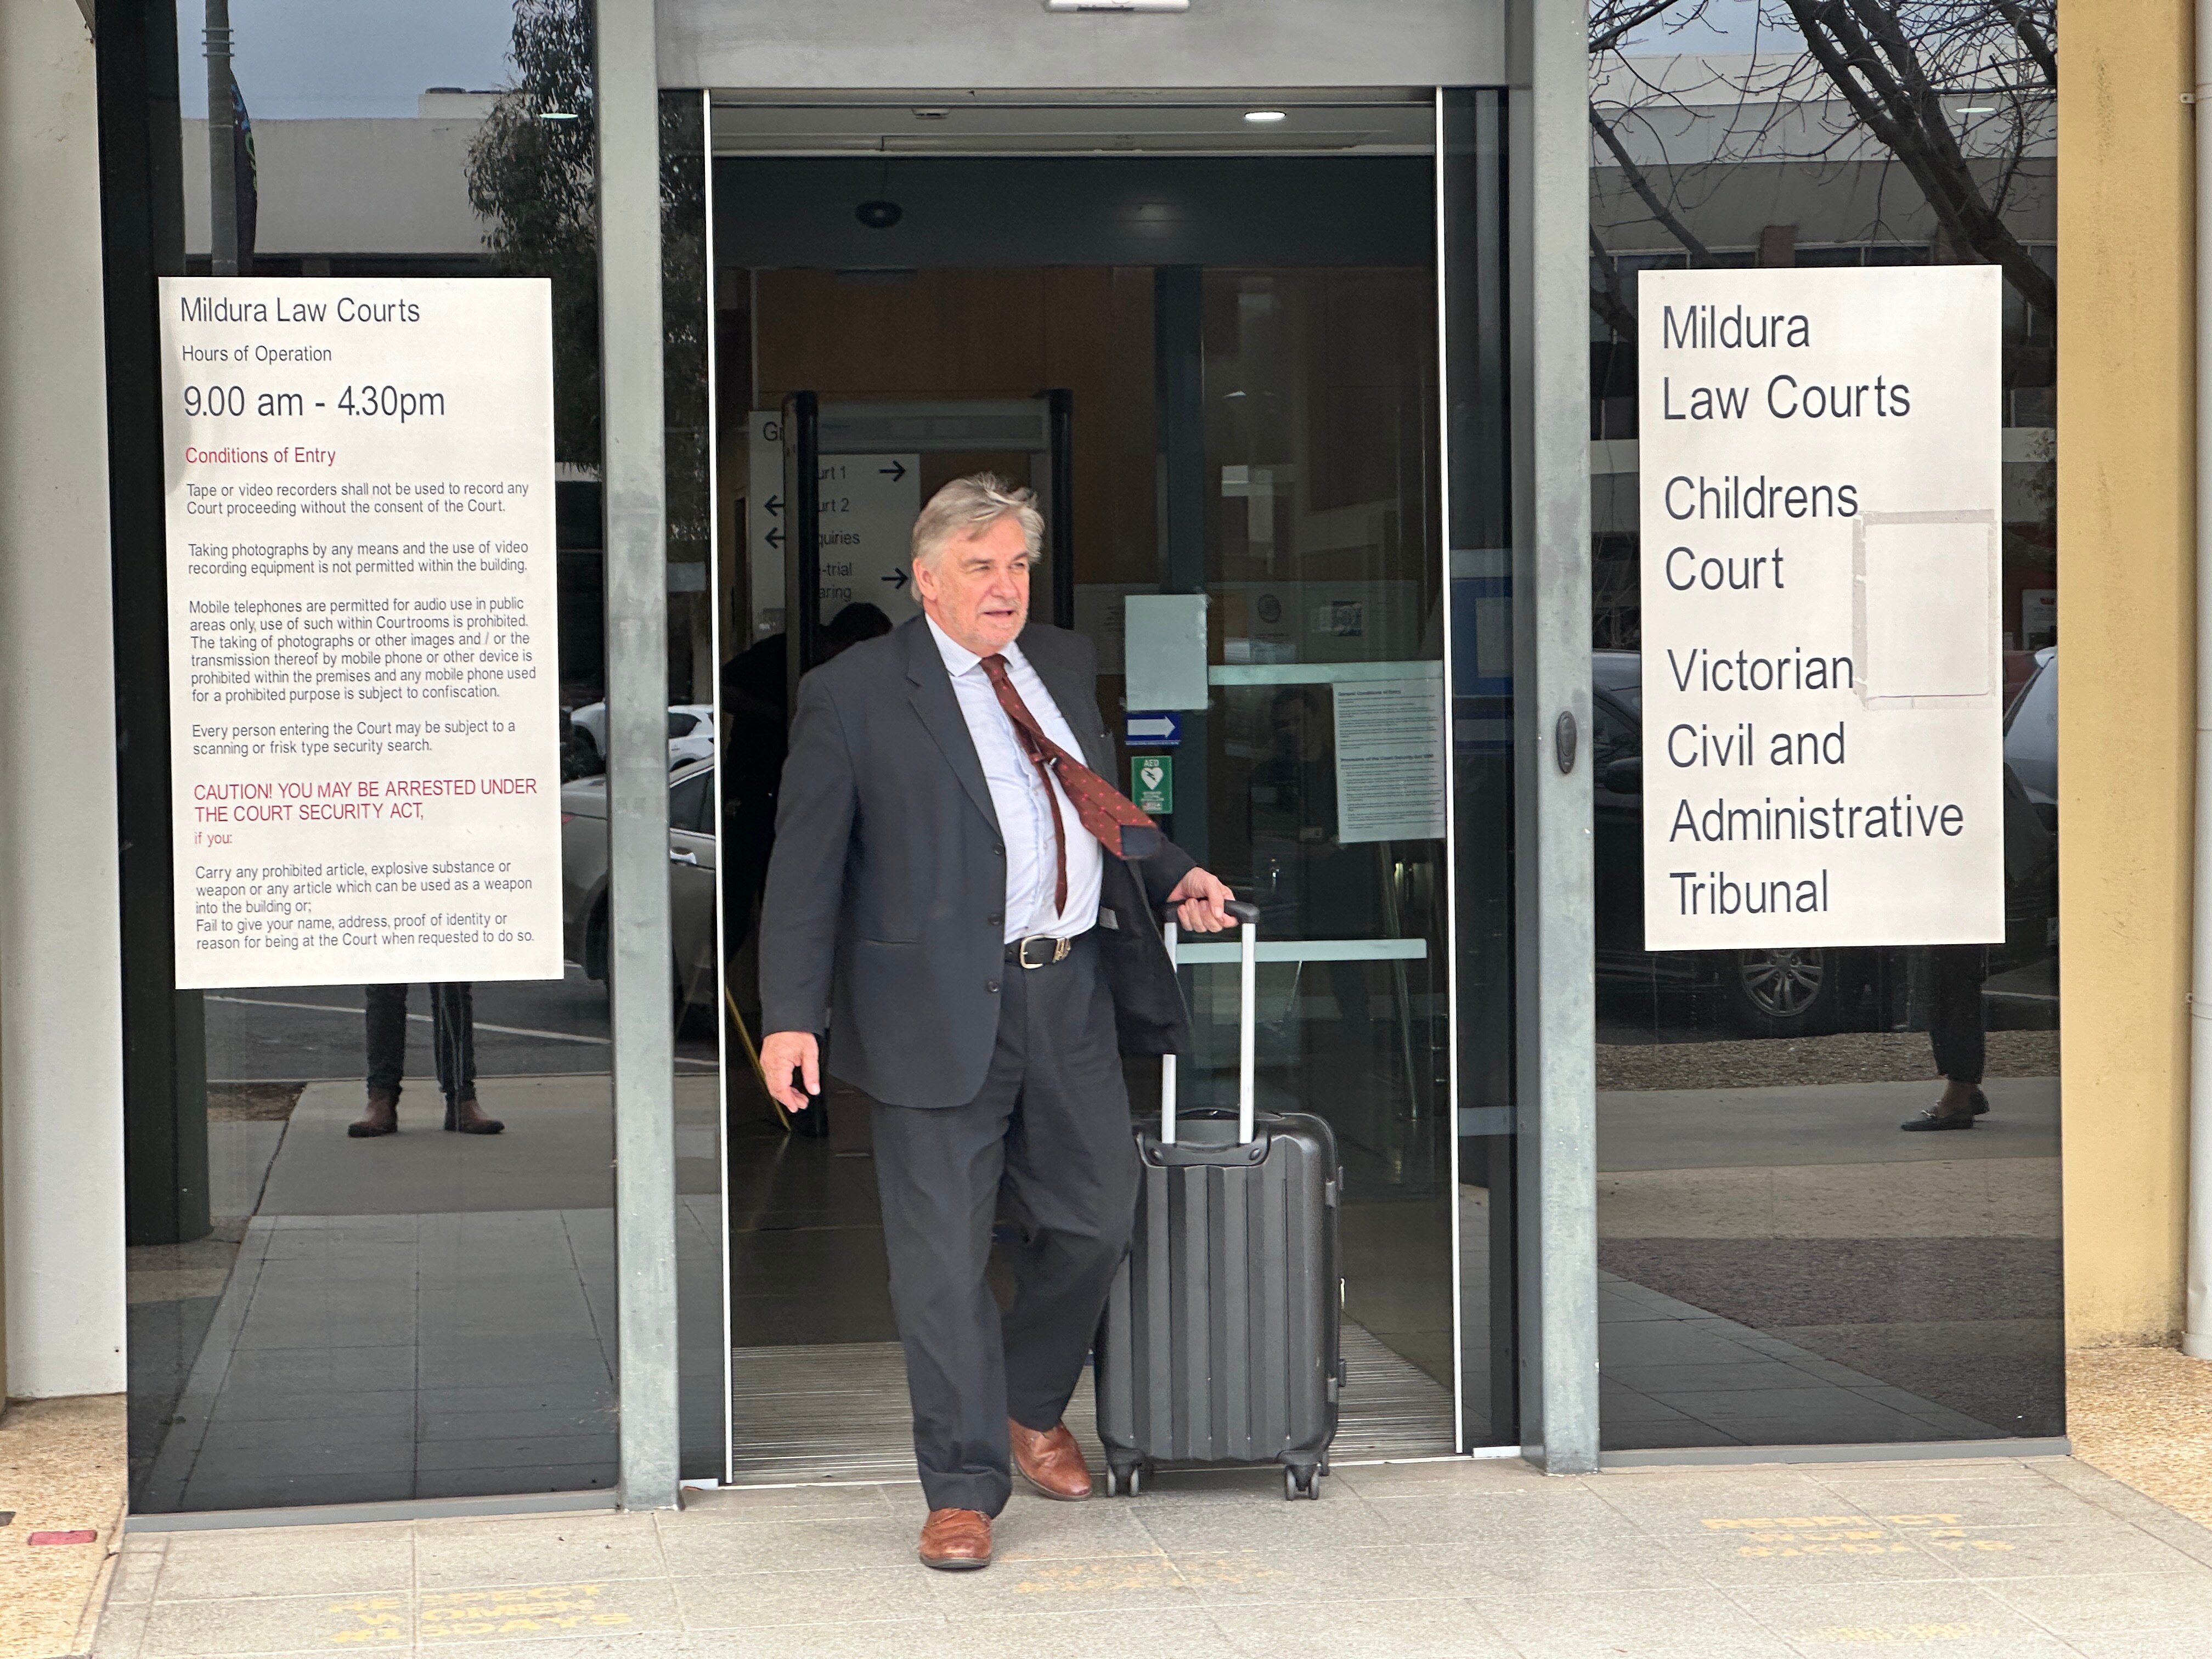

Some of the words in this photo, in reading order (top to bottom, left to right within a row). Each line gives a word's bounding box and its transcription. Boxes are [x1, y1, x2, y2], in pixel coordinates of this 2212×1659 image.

[181, 297, 267, 322] Mildura
[277, 297, 327, 322] Law
[337, 297, 420, 322] Courts
[1664, 304, 1809, 348] Mildura
[183, 345, 228, 362] Hours
[234, 345, 249, 362] of
[255, 345, 331, 365] Operation
[184, 386, 245, 416] 9.00
[258, 393, 303, 416] am
[337, 385, 444, 424] 4.30pm
[1664, 377, 1749, 420] Law
[1768, 375, 1910, 419] Courts
[185, 447, 268, 464] Conditions
[274, 447, 289, 463] of
[295, 447, 336, 467] Entry
[818, 466, 835, 479] urt
[840, 466, 845, 479] 1
[187, 483, 217, 500] Tape
[221, 487, 234, 496] or
[239, 483, 273, 496] video
[277, 483, 337, 496] recorders
[341, 482, 369, 495] shall
[373, 483, 392, 495] not
[396, 482, 411, 495] be
[415, 482, 444, 495] used
[449, 483, 460, 494] to
[464, 482, 503, 494] record
[507, 484, 529, 497] any
[1666, 476, 1858, 520] Childrens
[187, 501, 223, 514] Court
[227, 500, 296, 517] proceeding
[301, 500, 346, 514] without
[351, 500, 370, 513] the
[374, 500, 424, 513] consent
[427, 499, 440, 512] of
[444, 499, 464, 512] the
[468, 499, 505, 512] Court.
[818, 499, 836, 512] urt
[841, 498, 849, 512] 2
[818, 530, 860, 548] quiries
[188, 543, 228, 560] Taking
[232, 543, 309, 560] photographs
[313, 543, 327, 558] by
[331, 545, 353, 558] any
[358, 545, 399, 555] means
[403, 541, 425, 555] and
[430, 541, 449, 554] the
[453, 544, 475, 554] use
[479, 540, 491, 554] of
[495, 540, 528, 553] video
[189, 561, 247, 577] recording
[251, 560, 315, 577] equipment
[319, 560, 329, 573] is
[332, 561, 352, 573] not
[356, 559, 414, 575] permitted
[418, 558, 453, 572] within
[457, 558, 476, 571] the
[481, 558, 527, 574] building.
[821, 562, 853, 575] -trial
[1666, 547, 1784, 590] Court
[819, 585, 851, 602] aring
[190, 600, 229, 614] Mobile
[234, 600, 302, 616] telephones
[306, 602, 326, 612] are
[330, 598, 389, 615] permitted
[393, 598, 410, 611] for
[414, 597, 447, 611] audio
[450, 600, 472, 610] use
[476, 597, 486, 610] in
[490, 596, 524, 613] public
[191, 670, 250, 687] prohibited
[254, 670, 289, 684] within
[293, 670, 312, 683] the
[316, 669, 371, 686] premises
[374, 668, 397, 681] and
[400, 671, 421, 684] any
[425, 668, 464, 681] mobile
[467, 667, 504, 684] phone
[507, 666, 536, 679] used
[1667, 647, 1853, 691] Victorian
[192, 689, 209, 702] for
[214, 692, 221, 702] a
[225, 687, 286, 704] prohibited
[290, 690, 340, 704] purpose
[344, 686, 354, 699] is
[358, 686, 403, 702] subject
[407, 686, 418, 698] to
[422, 684, 499, 698] confiscation.
[193, 724, 228, 741] Every
[233, 726, 275, 740] person
[280, 723, 329, 738] entering
[334, 723, 353, 735] the
[357, 722, 392, 735] Court
[396, 724, 421, 737] may
[425, 720, 441, 733] be
[445, 720, 488, 736] subject
[493, 720, 504, 732] to
[508, 722, 515, 732] a
[193, 741, 249, 757] scanning
[252, 744, 266, 754] or
[270, 741, 297, 753] frisk
[302, 741, 329, 756] type
[334, 739, 383, 755] security
[388, 738, 432, 752] search.
[1668, 723, 1752, 768] Civil
[1771, 721, 1844, 765] and
[194, 783, 272, 800] CAUTION!
[278, 782, 312, 798] YOU
[318, 782, 352, 798] MAY
[358, 781, 380, 797] BE
[385, 780, 476, 797] ARRESTED
[481, 778, 537, 794] UNDER
[194, 806, 228, 822] THE
[234, 805, 293, 821] COURT
[299, 803, 383, 820] SECURITY
[390, 802, 424, 819] ACT,
[1669, 794, 1963, 842] Administrative
[194, 832, 202, 844] if
[207, 834, 232, 847] you:
[196, 866, 232, 882] Carry
[236, 868, 258, 881] any
[262, 864, 322, 881] prohibited
[326, 863, 368, 877] article,
[371, 861, 428, 878] explosive
[432, 861, 494, 873] substance
[499, 862, 511, 872] or
[1670, 870, 1827, 915] Tribunal
[196, 901, 218, 914] into
[222, 901, 242, 913] the
[246, 900, 291, 915] building
[296, 902, 311, 912] or;
[196, 919, 217, 932] Fail
[221, 919, 233, 931] to
[238, 918, 262, 934] give
[267, 920, 294, 933] your
[298, 919, 335, 930] name,
[338, 915, 391, 929] address,
[394, 913, 426, 930] proof
[431, 913, 443, 926] of
[447, 912, 490, 928] identity
[495, 915, 507, 924] or
